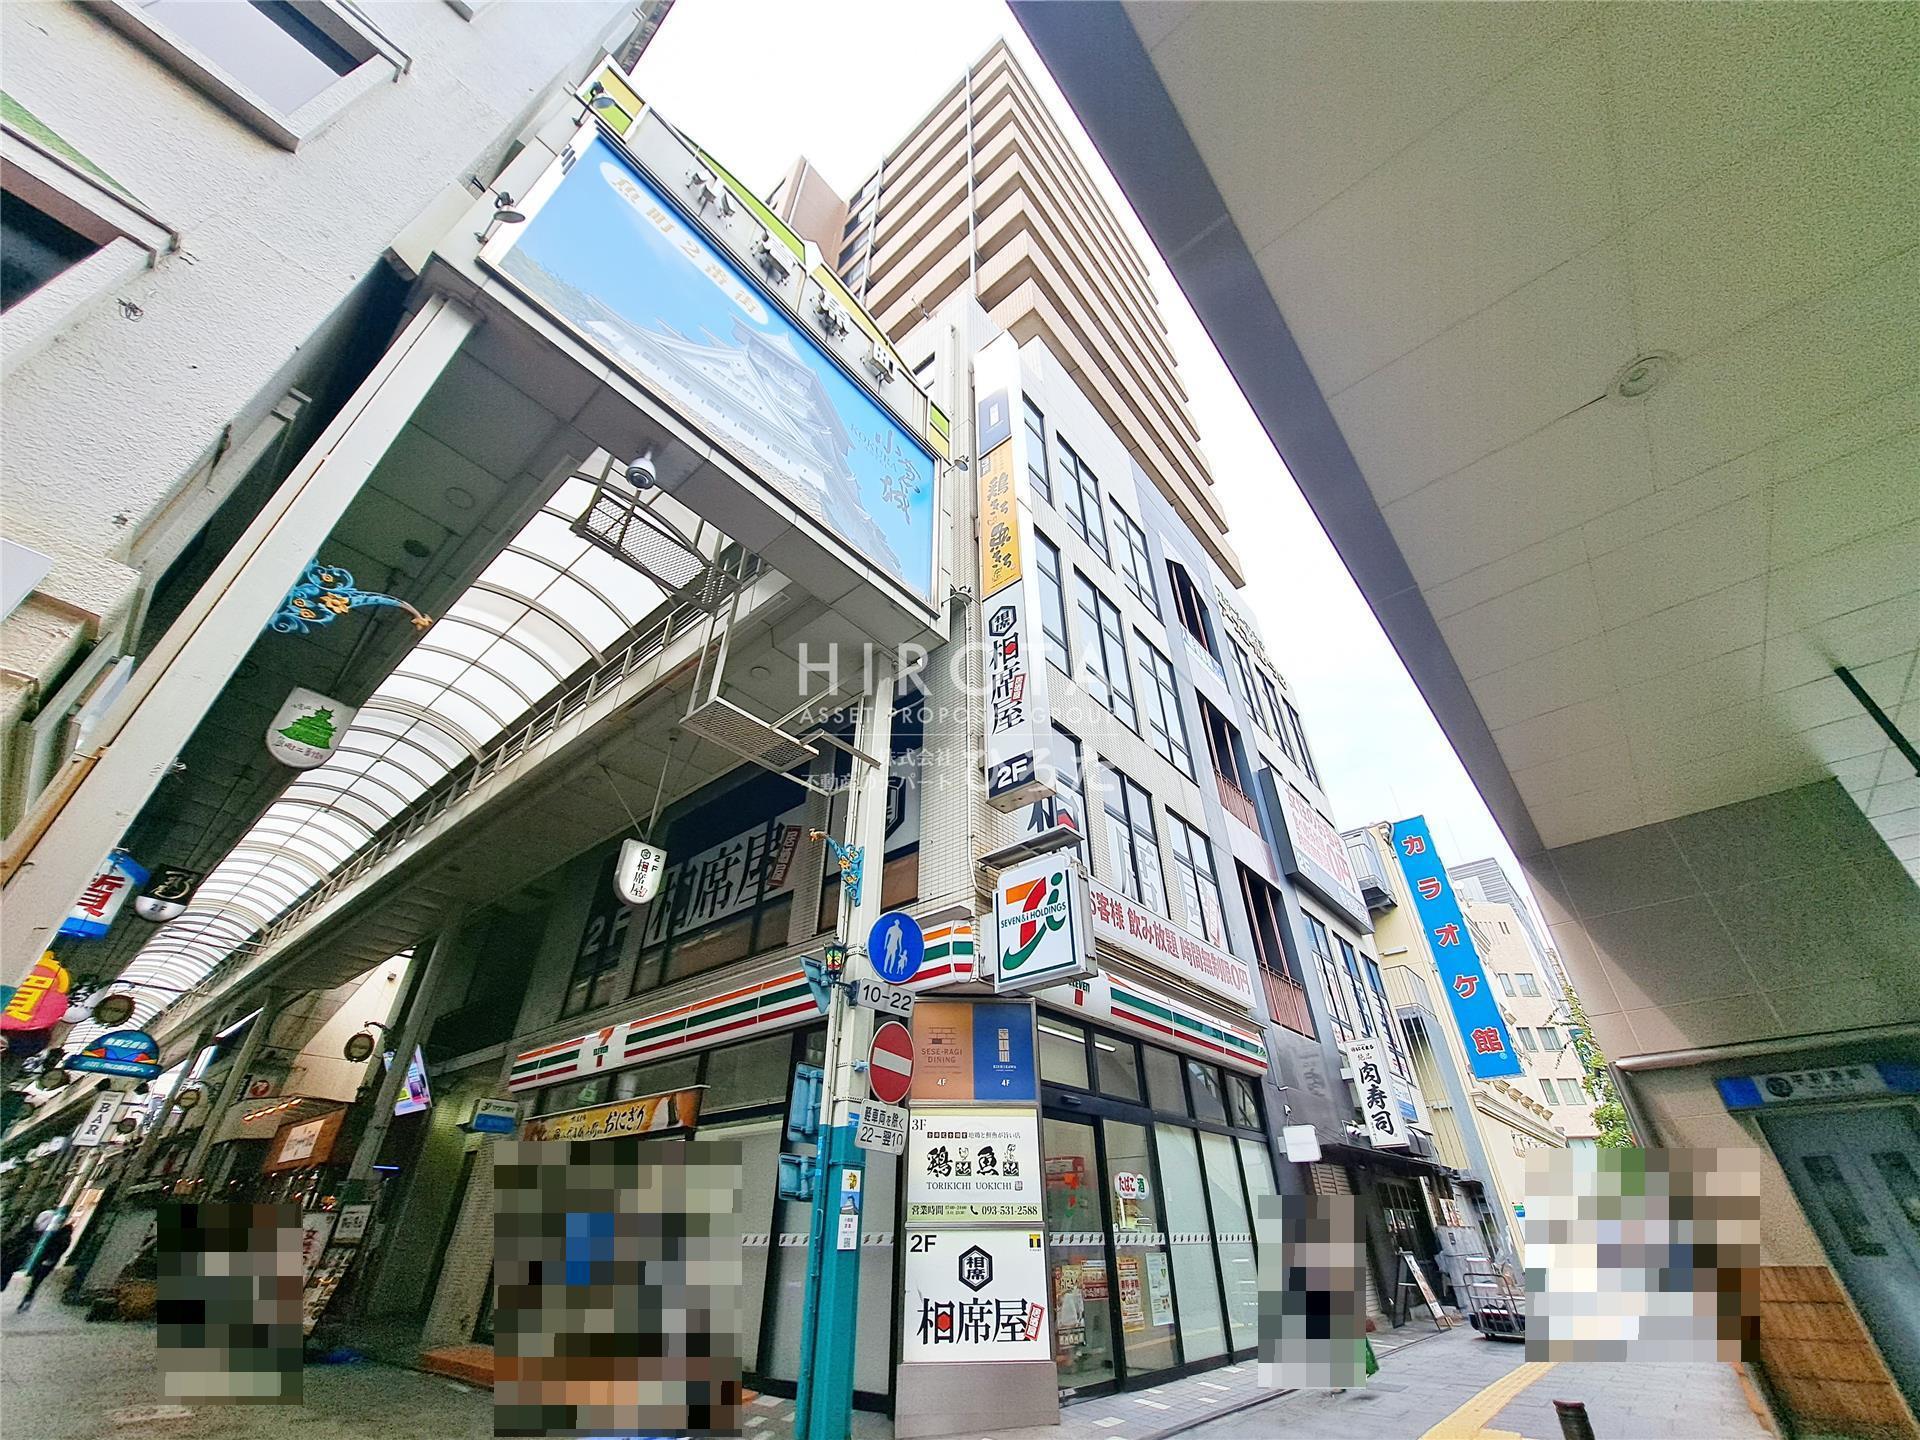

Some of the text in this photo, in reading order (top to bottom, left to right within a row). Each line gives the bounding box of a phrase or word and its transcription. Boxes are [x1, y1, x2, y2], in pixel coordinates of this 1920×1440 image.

[989, 632, 1025, 736] 相席屋
[997, 757, 1028, 789] 2F
[1030, 901, 1067, 920] HOLDINGS
[1127, 907, 1180, 959] 飲み放題
[1179, 936, 1251, 995] 時間無制限0円
[1402, 834, 1505, 1055] カラオケ館
[863, 984, 911, 1012] 10-22
[937, 1078, 946, 1086] 4F
[1359, 1061, 1394, 1136] 肉寿司
[85, 1102, 111, 1136] BAR
[604, 1104, 646, 1134] おにぎり
[864, 1105, 904, 1130] 軽車両を除く
[911, 1118, 927, 1131] 3F
[926, 1181, 971, 1190] TORIKICHI
[975, 1181, 1012, 1190] UOKICHI
[1119, 1175, 1136, 1192] たばこ
[911, 1204, 944, 1215] 営業時間
[981, 1205, 1038, 1216] 093-531-2588
[910, 1234, 937, 1253] 2F
[966, 1256, 985, 1280] 相席
[917, 1297, 1030, 1345] 相席屋
